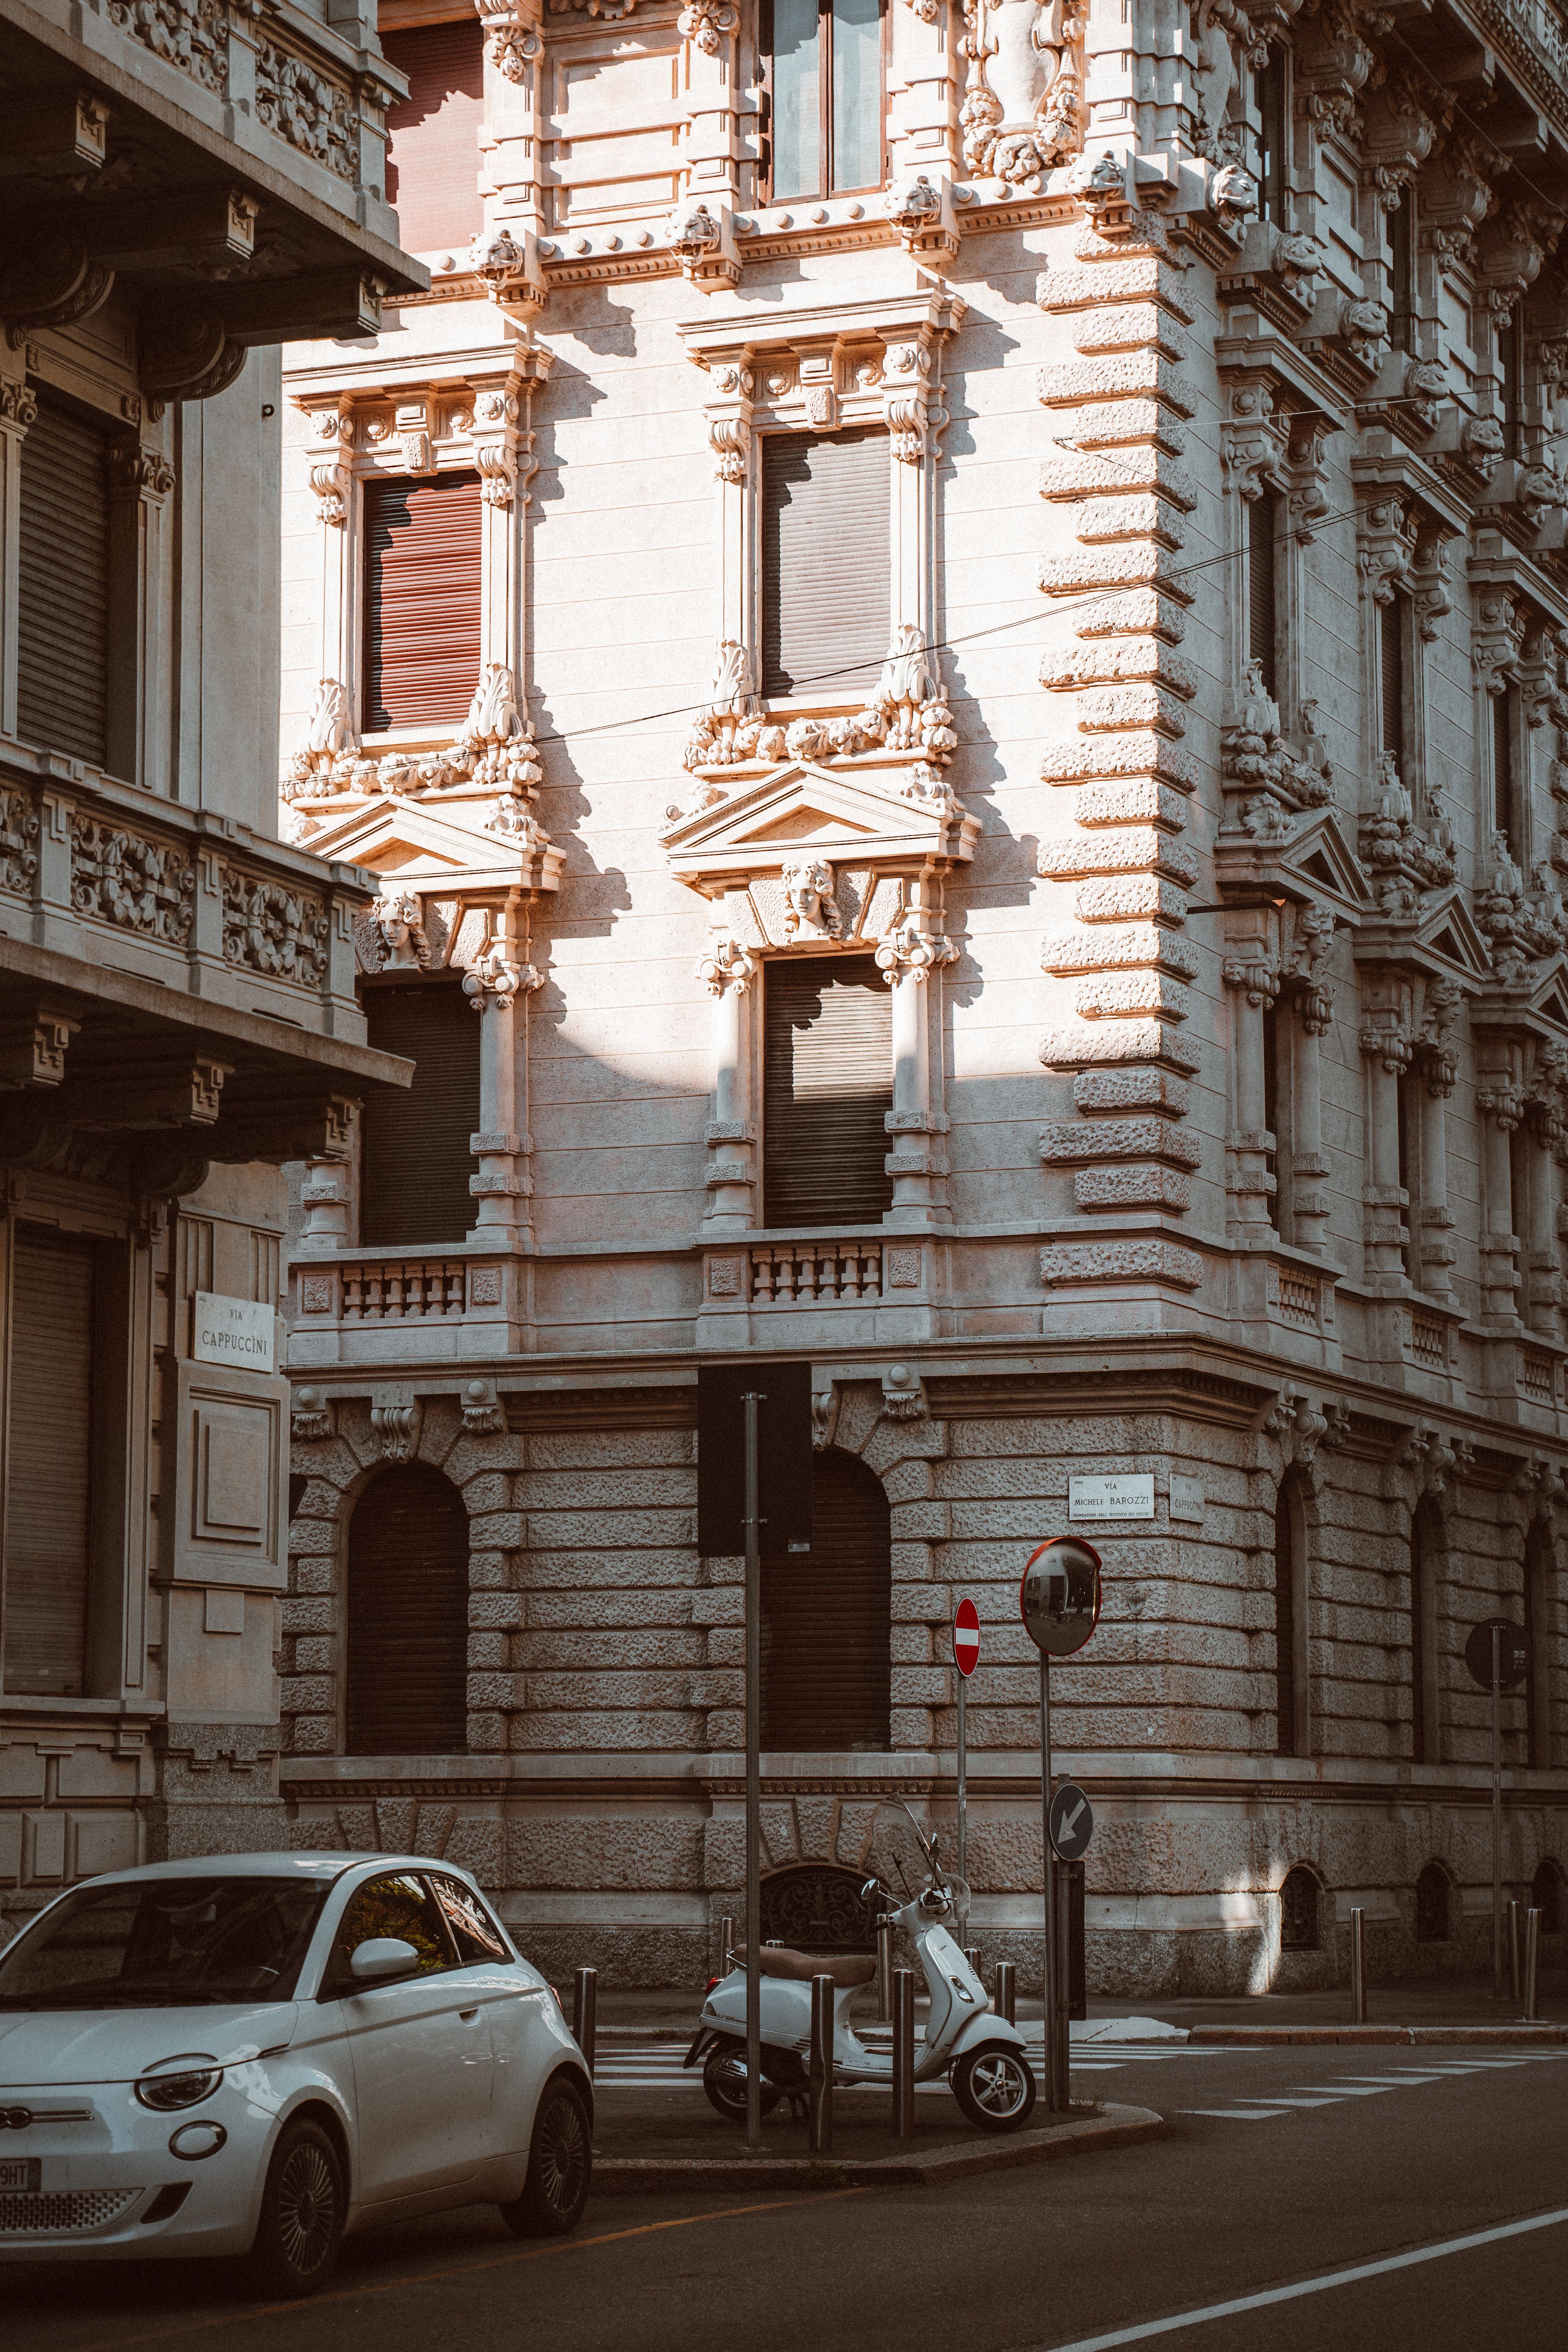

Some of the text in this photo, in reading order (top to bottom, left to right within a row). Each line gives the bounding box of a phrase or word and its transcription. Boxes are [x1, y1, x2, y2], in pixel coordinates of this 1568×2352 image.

[230, 1308, 242, 1320] VIA
[203, 1330, 267, 1355] CAPPUCCINI
[1110, 1496, 1149, 1505] BAROZZI
[1175, 1498, 1202, 1512] CAPPUCCINI
